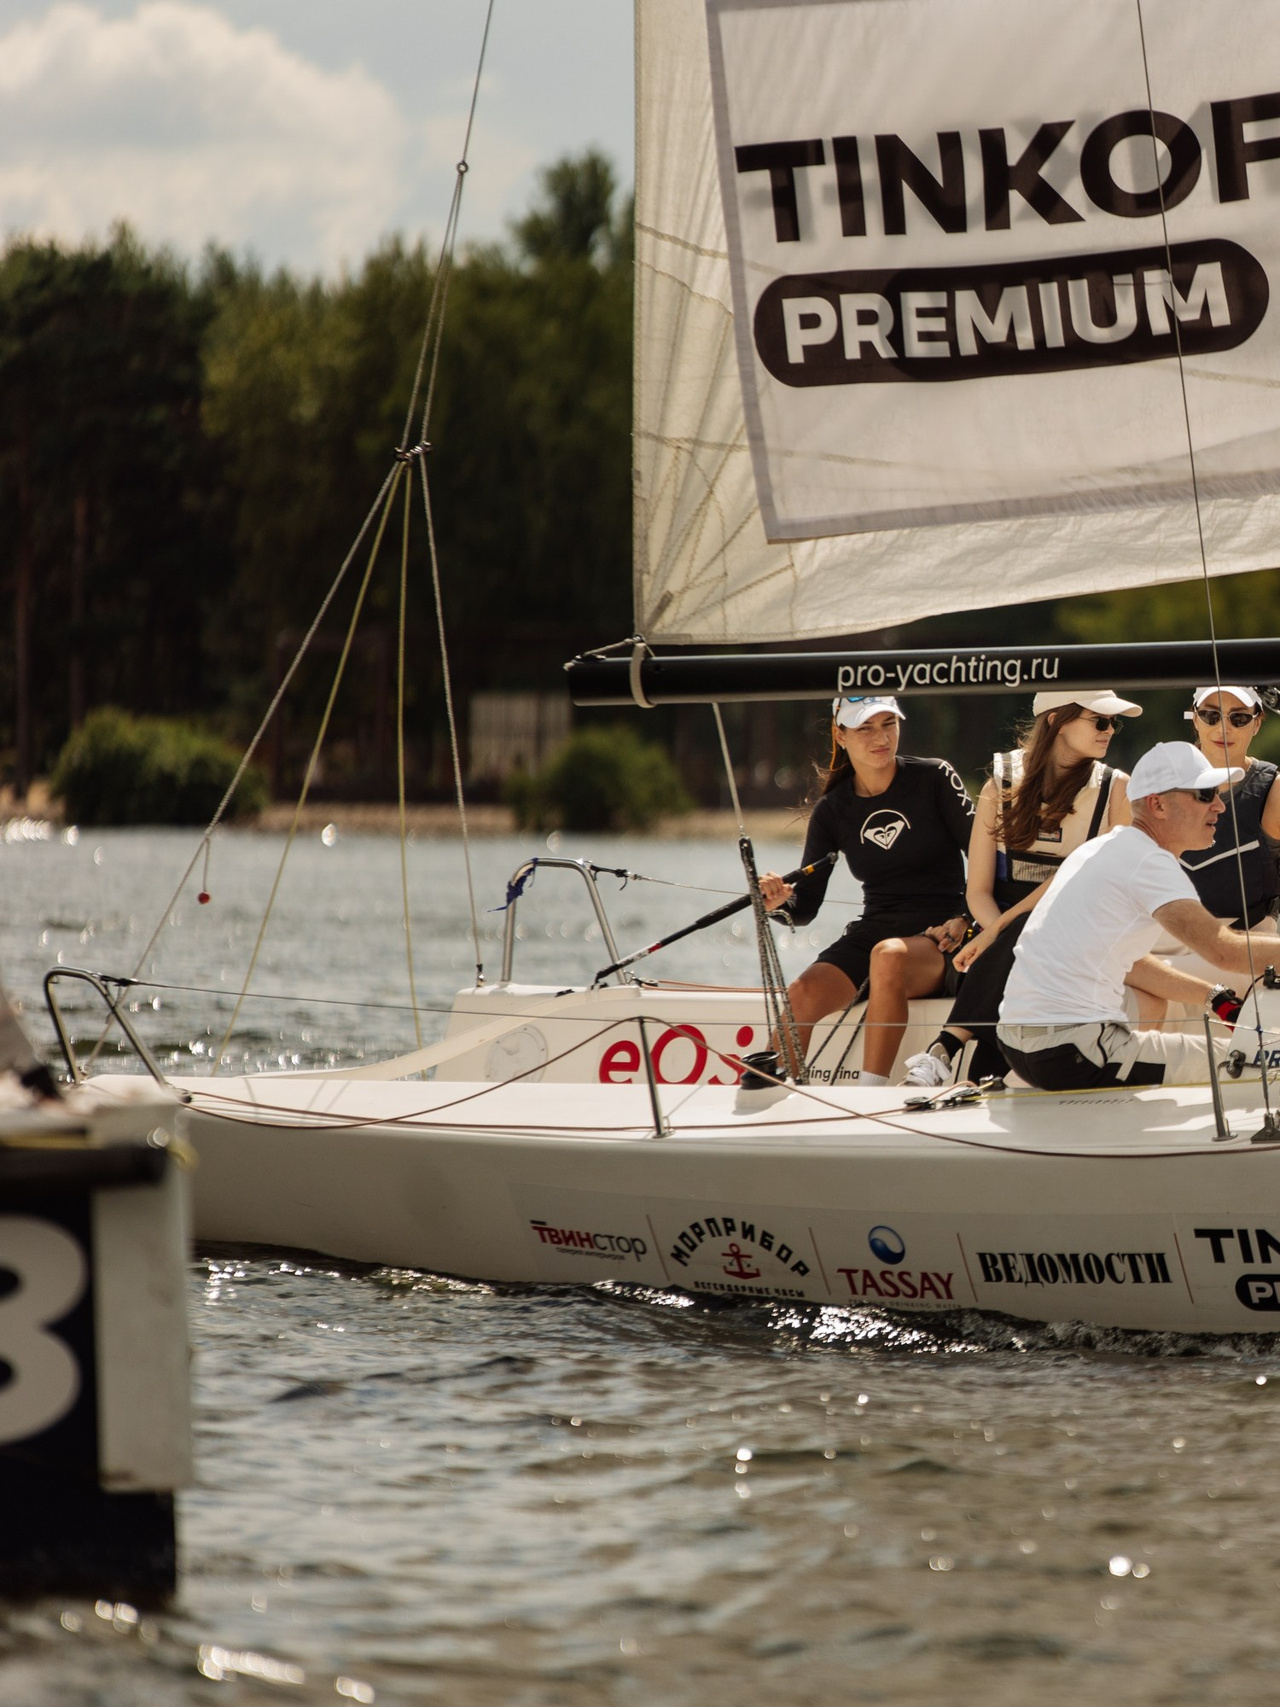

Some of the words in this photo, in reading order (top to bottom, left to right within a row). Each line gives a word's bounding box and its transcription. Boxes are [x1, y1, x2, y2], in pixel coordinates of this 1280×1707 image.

[782, 262, 1231, 364] PREMIUM
[837, 654, 1060, 692] pro-yachting.ru
[938, 761, 977, 816] ROXY
[670, 1217, 810, 1277] МОРПРИБОР
[976, 1252, 1172, 1286] ВЕДОМОСТИ
[836, 1267, 954, 1300] TASSAY
